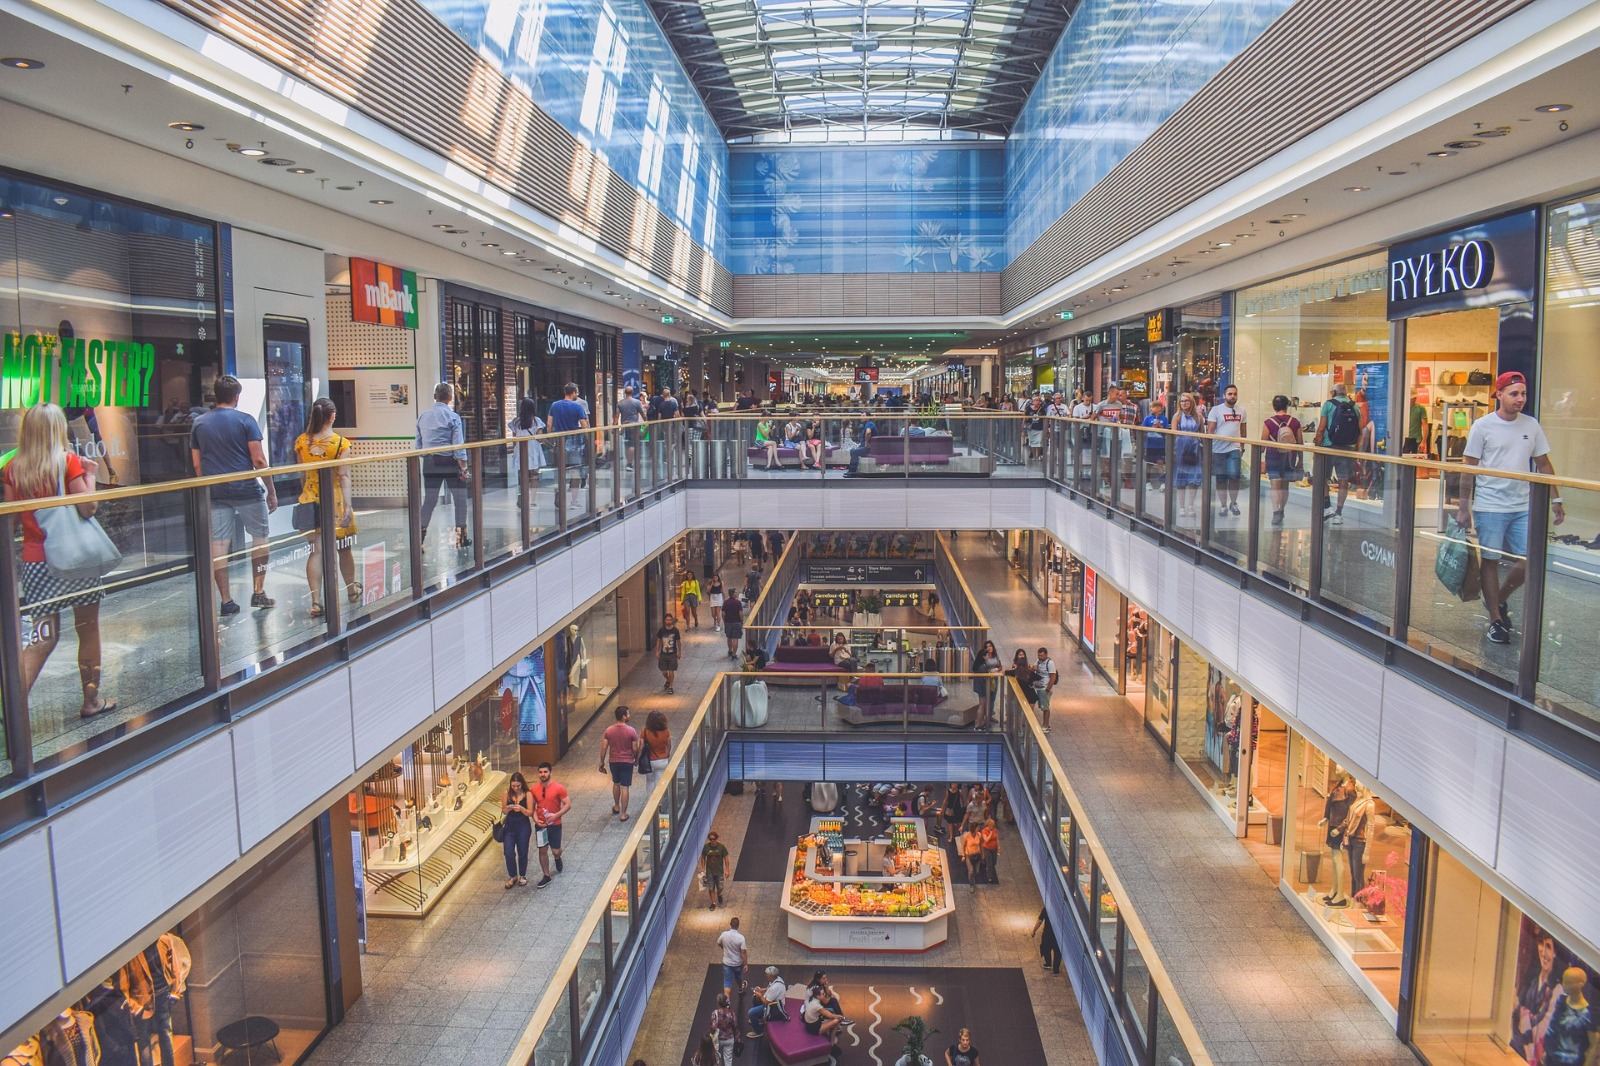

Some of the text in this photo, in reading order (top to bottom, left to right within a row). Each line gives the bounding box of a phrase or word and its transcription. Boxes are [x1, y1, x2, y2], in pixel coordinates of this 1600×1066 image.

[1391, 240, 1484, 302] RYŁKO
[364, 281, 415, 314] mBank
[1, 333, 155, 409] NOT FASTER?
[85, 432, 107, 458] do
[110, 433, 126, 456] it.
[502, 701, 513, 718] SALE
